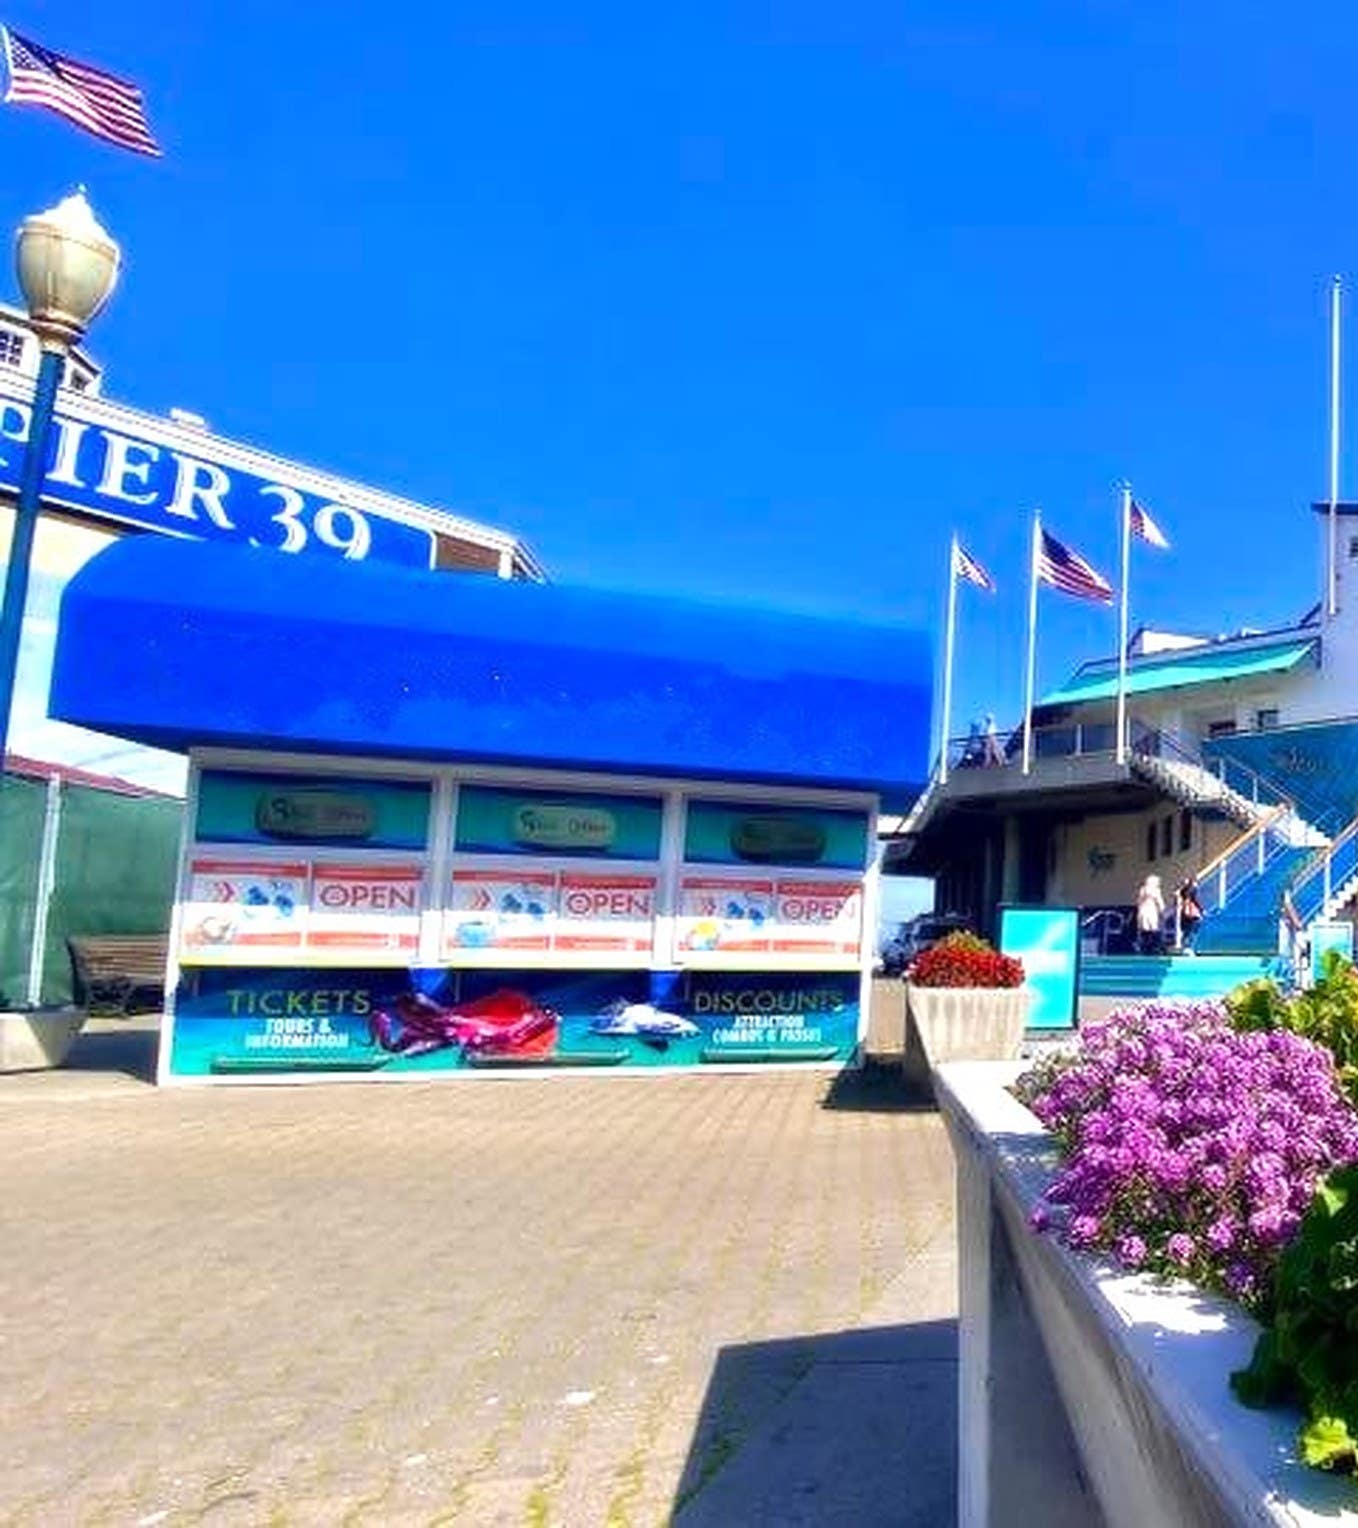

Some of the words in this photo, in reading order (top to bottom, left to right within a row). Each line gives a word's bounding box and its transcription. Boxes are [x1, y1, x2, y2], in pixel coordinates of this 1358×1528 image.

[248, 483, 372, 561] 39
[320, 884, 416, 909] OPEN
[566, 892, 650, 917] OPEN
[225, 989, 371, 1015] TICKETS
[694, 990, 843, 1013] DISCOUNTS
[265, 1017, 315, 1034] TOURS
[245, 1033, 349, 1049] INFORMATION
